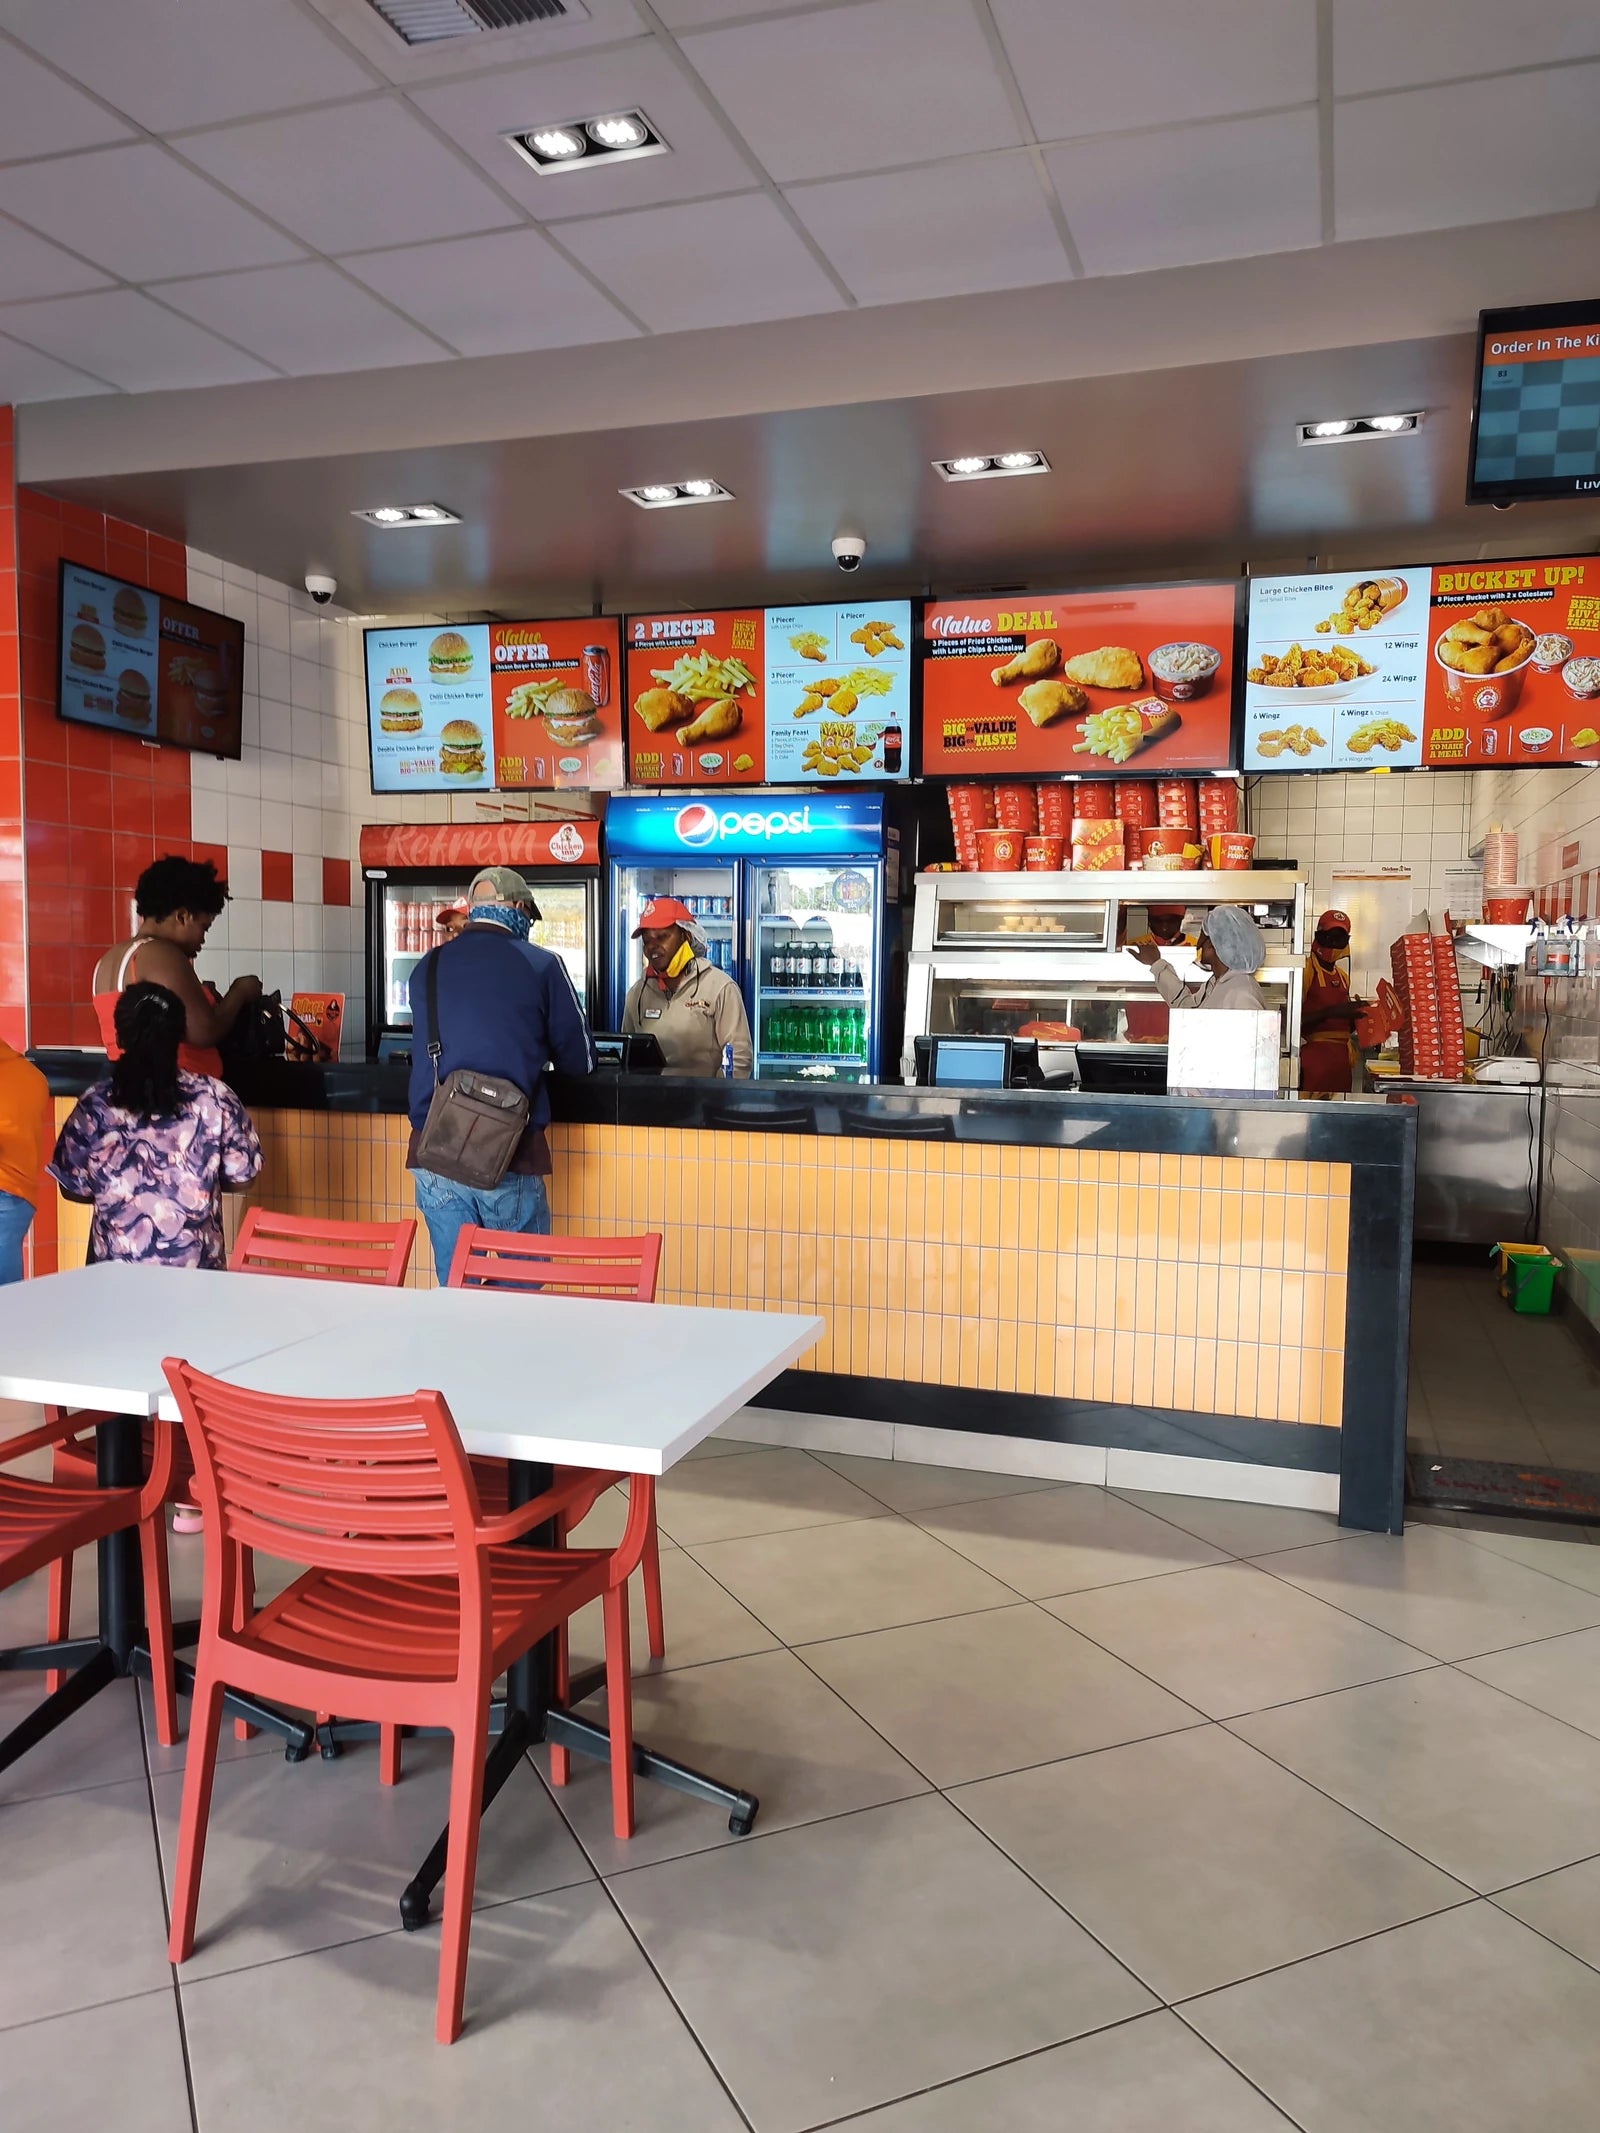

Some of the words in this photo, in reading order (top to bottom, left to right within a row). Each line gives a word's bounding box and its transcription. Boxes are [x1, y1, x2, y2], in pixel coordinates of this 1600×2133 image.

[1491, 340, 1532, 355] Order
[1537, 340, 1550, 350] In
[1556, 336, 1580, 349] The
[1498, 370, 1507, 378] 83
[1438, 568, 1536, 592] BUCKET
[1544, 566, 1585, 586] UP!
[1260, 588, 1281, 596] Large
[1284, 586, 1312, 594] Chicken
[1314, 584, 1334, 592] Bites
[1518, 590, 1552, 598] Coleslaws
[1570, 600, 1600, 609] BEST
[163, 617, 200, 640] OFFER
[635, 623, 645, 639] 2
[651, 619, 716, 638] PIECER
[932, 615, 992, 637] Value
[998, 610, 1058, 632] DEAL
[1567, 618, 1600, 628] TASTE
[496, 630, 542, 647] Value
[666, 638, 680, 647] Large
[960, 638, 966, 646] of
[986, 636, 1012, 644] Chicken
[948, 647, 966, 655] Large
[968, 646, 986, 654] Chips
[994, 644, 1024, 652] Coleslaw
[1394, 641, 1418, 649] Wingz
[494, 644, 550, 662] OFFER
[466, 692, 484, 700] Burger
[1258, 712, 1280, 720] Wingz
[1346, 709, 1368, 717] Wingz
[772, 730, 792, 738] Family
[943, 723, 966, 736] BIG
[974, 721, 1016, 734] VALUE
[1430, 728, 1464, 741] ADD
[944, 736, 966, 748] BIG
[974, 733, 1016, 746] TASTE
[635, 752, 660, 764] ADD
[1438, 750, 1463, 758] MEAL
[500, 756, 522, 768] ADD
[719, 804, 812, 840] pepsi
[383, 823, 538, 867] Refresh
[551, 842, 582, 850] Chicken
